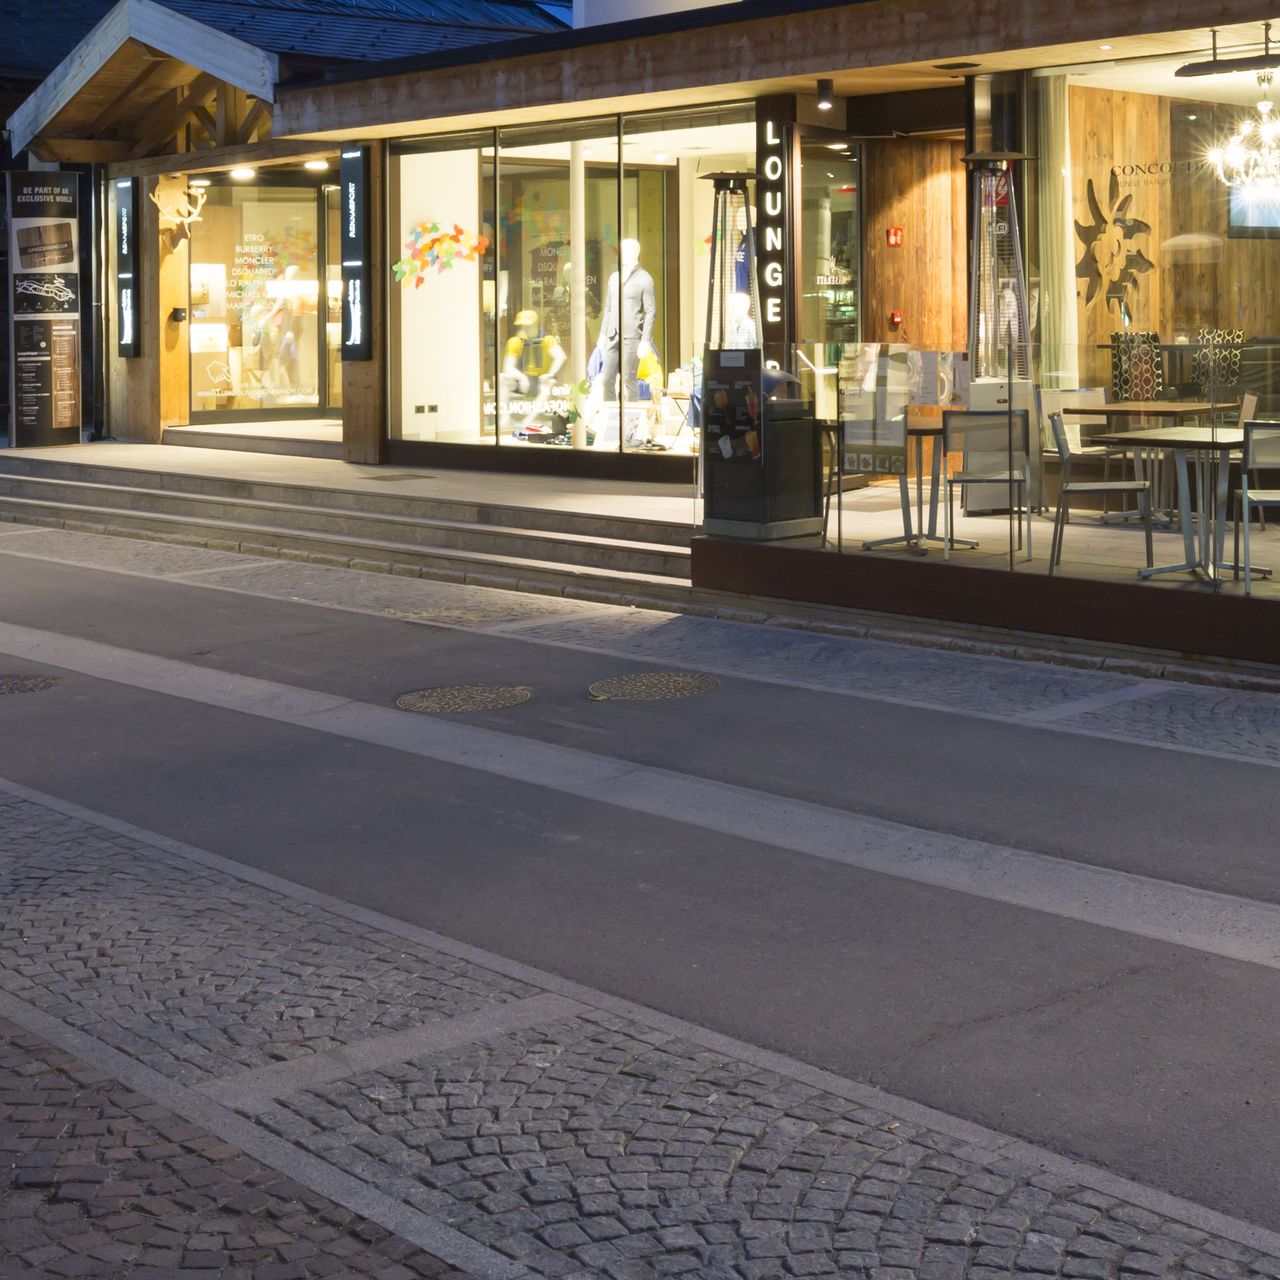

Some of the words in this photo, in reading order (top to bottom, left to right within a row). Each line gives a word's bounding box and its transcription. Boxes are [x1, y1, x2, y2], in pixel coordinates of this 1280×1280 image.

[23, 186, 32, 194] BE
[34, 186, 52, 194] PART
[17, 195, 54, 203] EXCLUSIVE
[765, 121, 782, 322] LOUNGE
[244, 234, 264, 242] ETRO
[235, 245, 274, 254] BURBERRY
[234, 256, 274, 265] MONCLER
